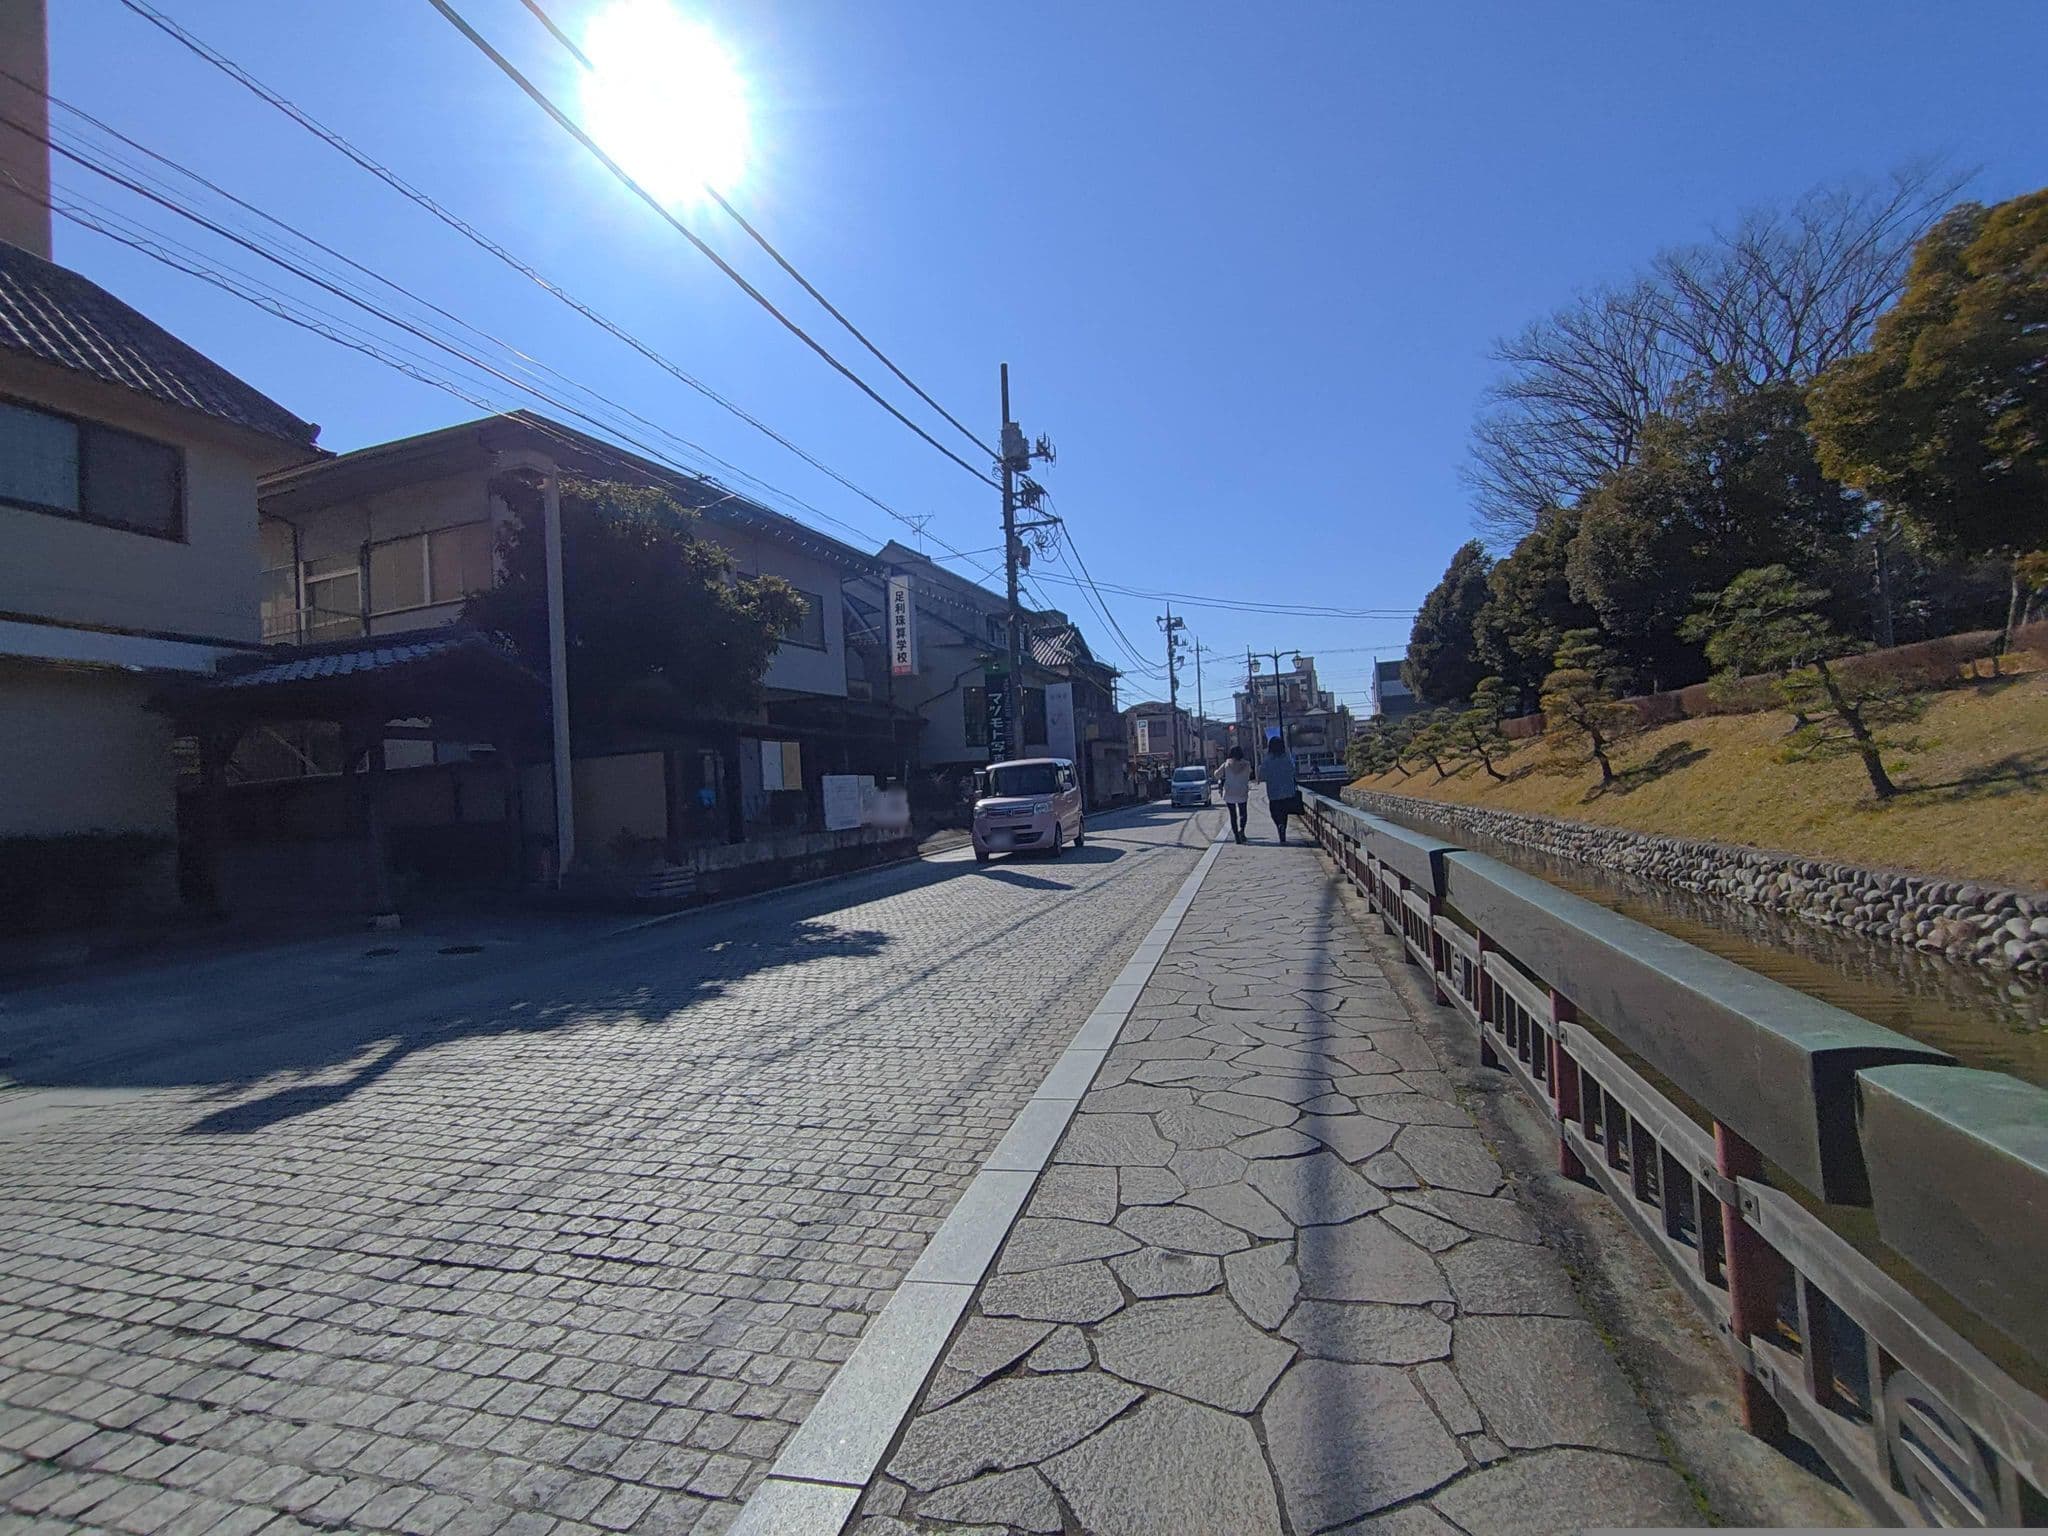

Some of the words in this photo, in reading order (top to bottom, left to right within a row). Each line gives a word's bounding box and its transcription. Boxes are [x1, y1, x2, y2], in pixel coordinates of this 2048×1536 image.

[894, 590, 908, 663] 足利珠算学校
